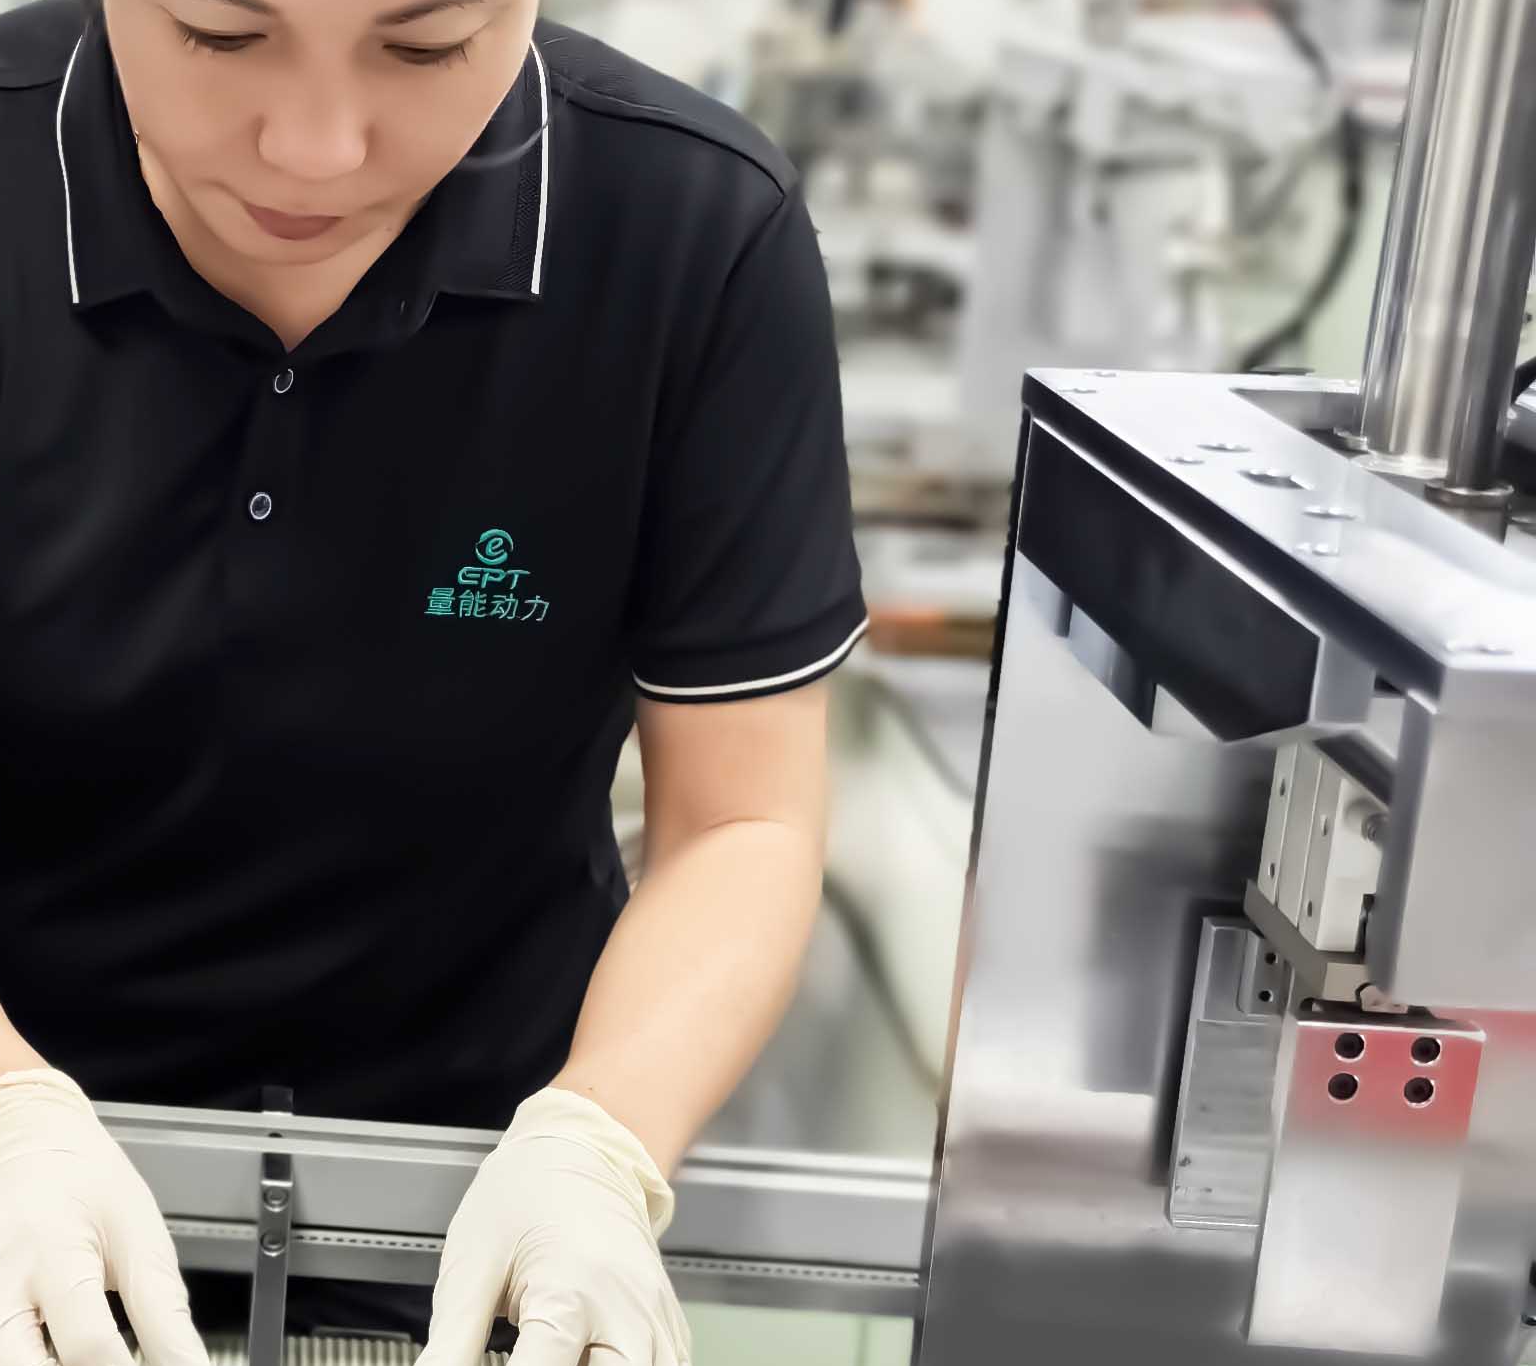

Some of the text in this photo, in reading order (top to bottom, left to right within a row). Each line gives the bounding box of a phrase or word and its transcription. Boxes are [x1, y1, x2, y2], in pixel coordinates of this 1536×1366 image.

[458, 566, 531, 589] EPT
[424, 588, 550, 621] 量能动力
